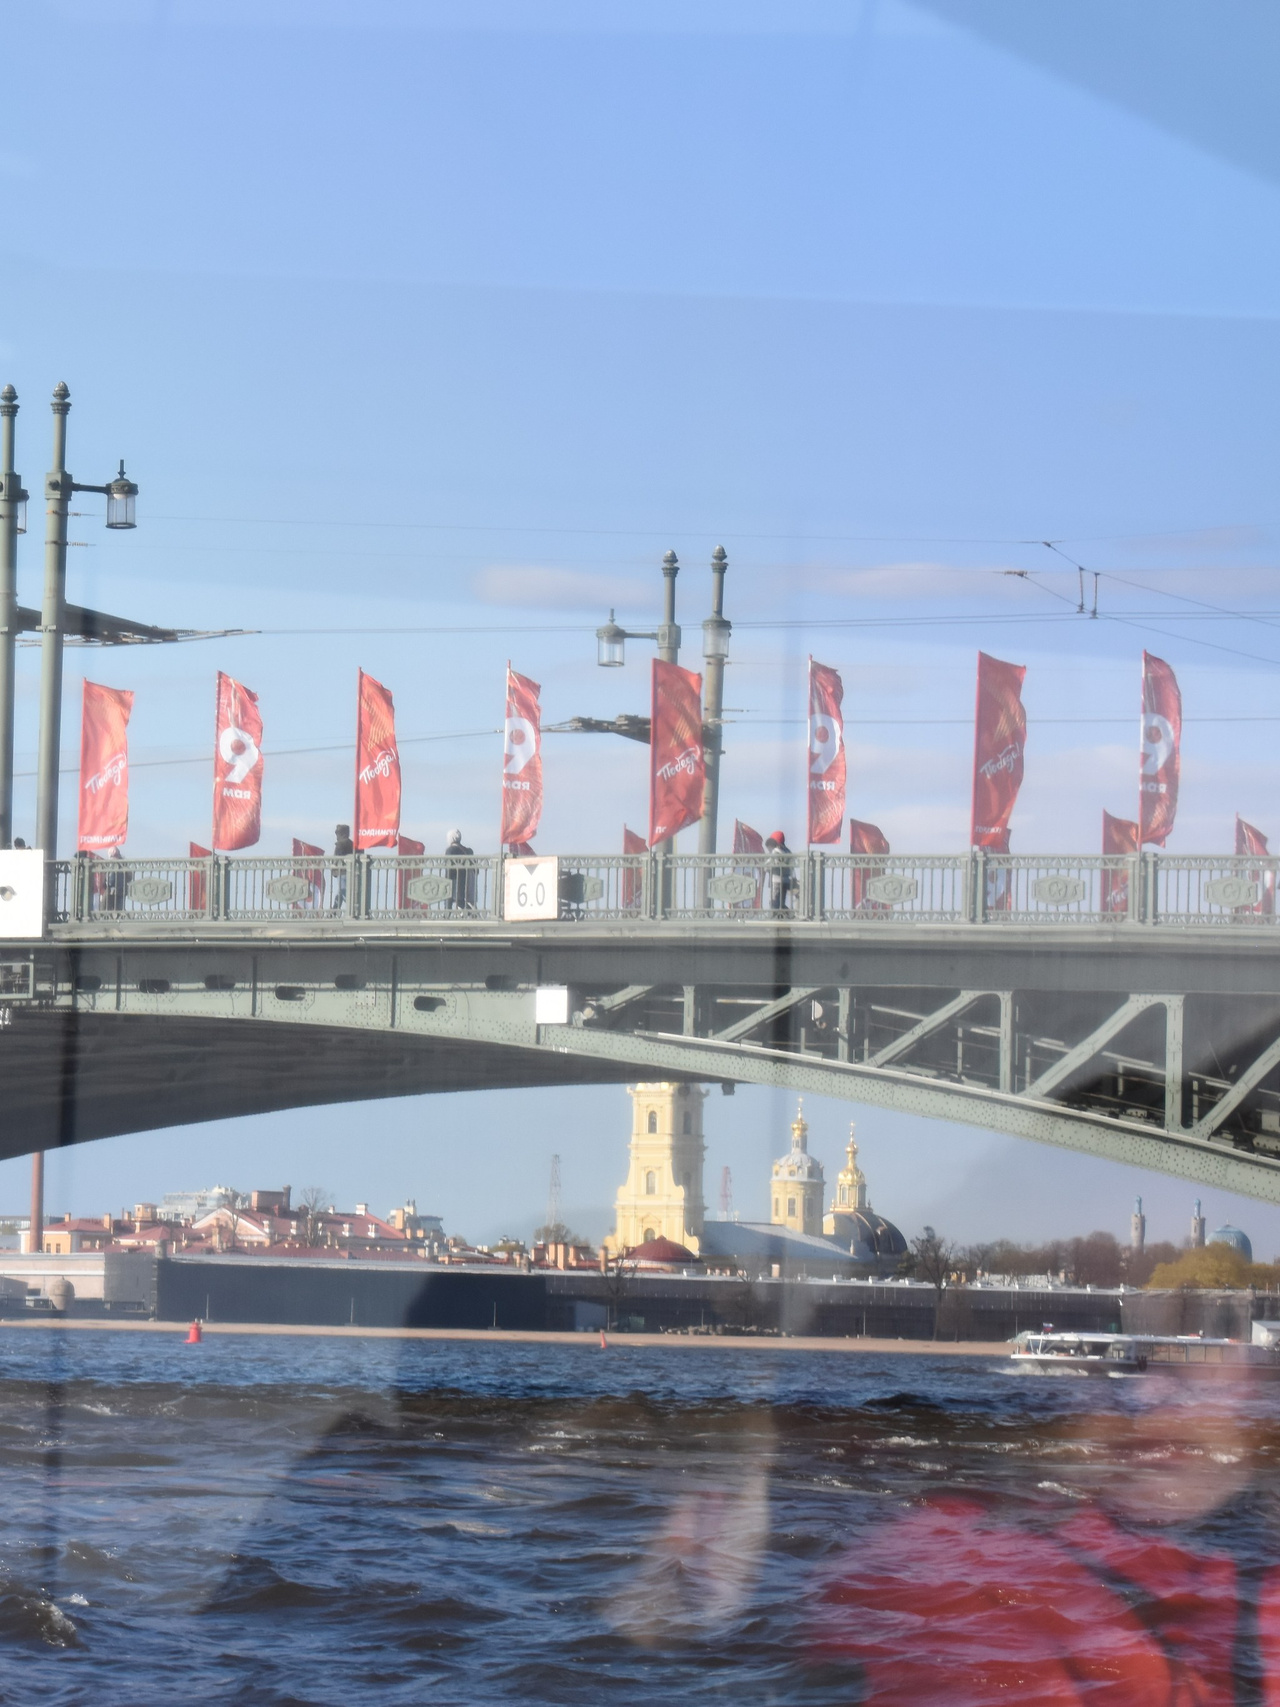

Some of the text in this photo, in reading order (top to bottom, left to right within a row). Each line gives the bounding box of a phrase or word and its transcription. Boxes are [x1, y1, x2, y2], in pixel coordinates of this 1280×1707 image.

[219, 726, 259, 784] 9
[504, 717, 536, 774] 9
[809, 713, 841, 774] 9
[1140, 712, 1175, 775] 9
[223, 787, 252, 800] мая
[517, 881, 546, 907] 6.0
